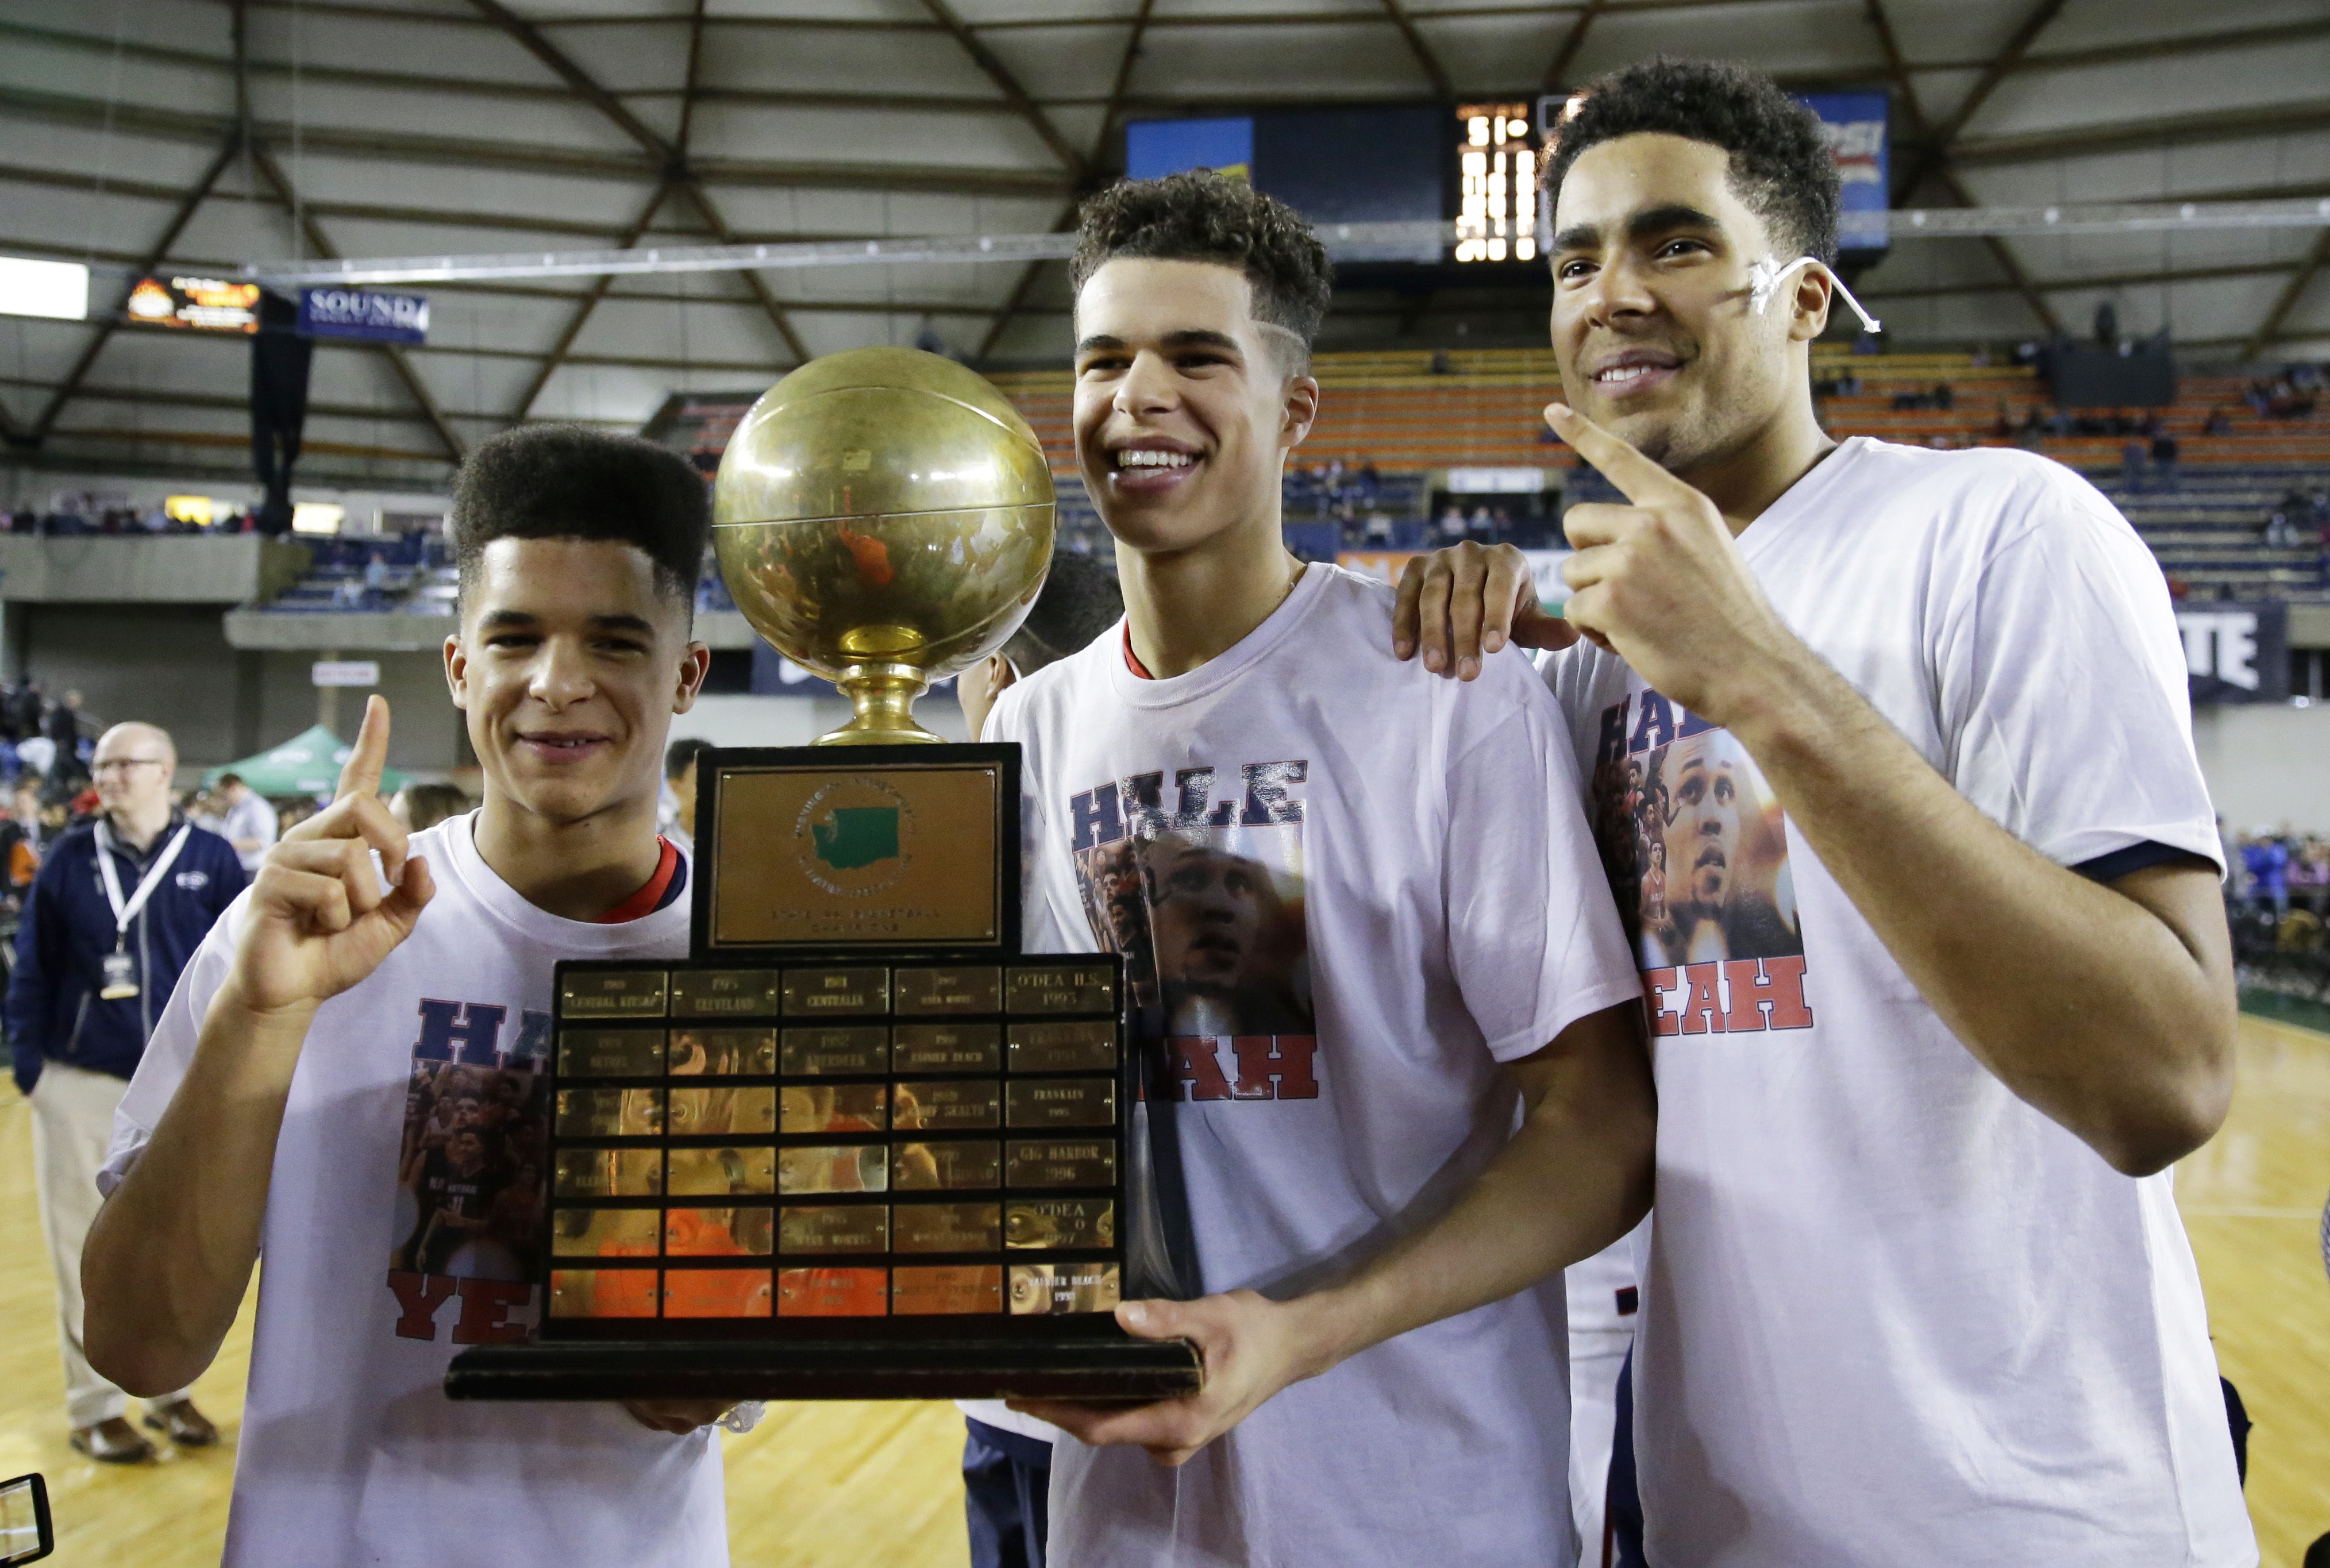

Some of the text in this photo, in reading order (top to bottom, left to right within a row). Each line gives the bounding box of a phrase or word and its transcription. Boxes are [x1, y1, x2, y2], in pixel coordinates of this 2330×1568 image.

[2177, 612, 2260, 690] TE
[1070, 760, 1308, 854] HALE
[1642, 955, 1813, 1037] EAH
[1035, 1204, 1085, 1217] O'DEA
